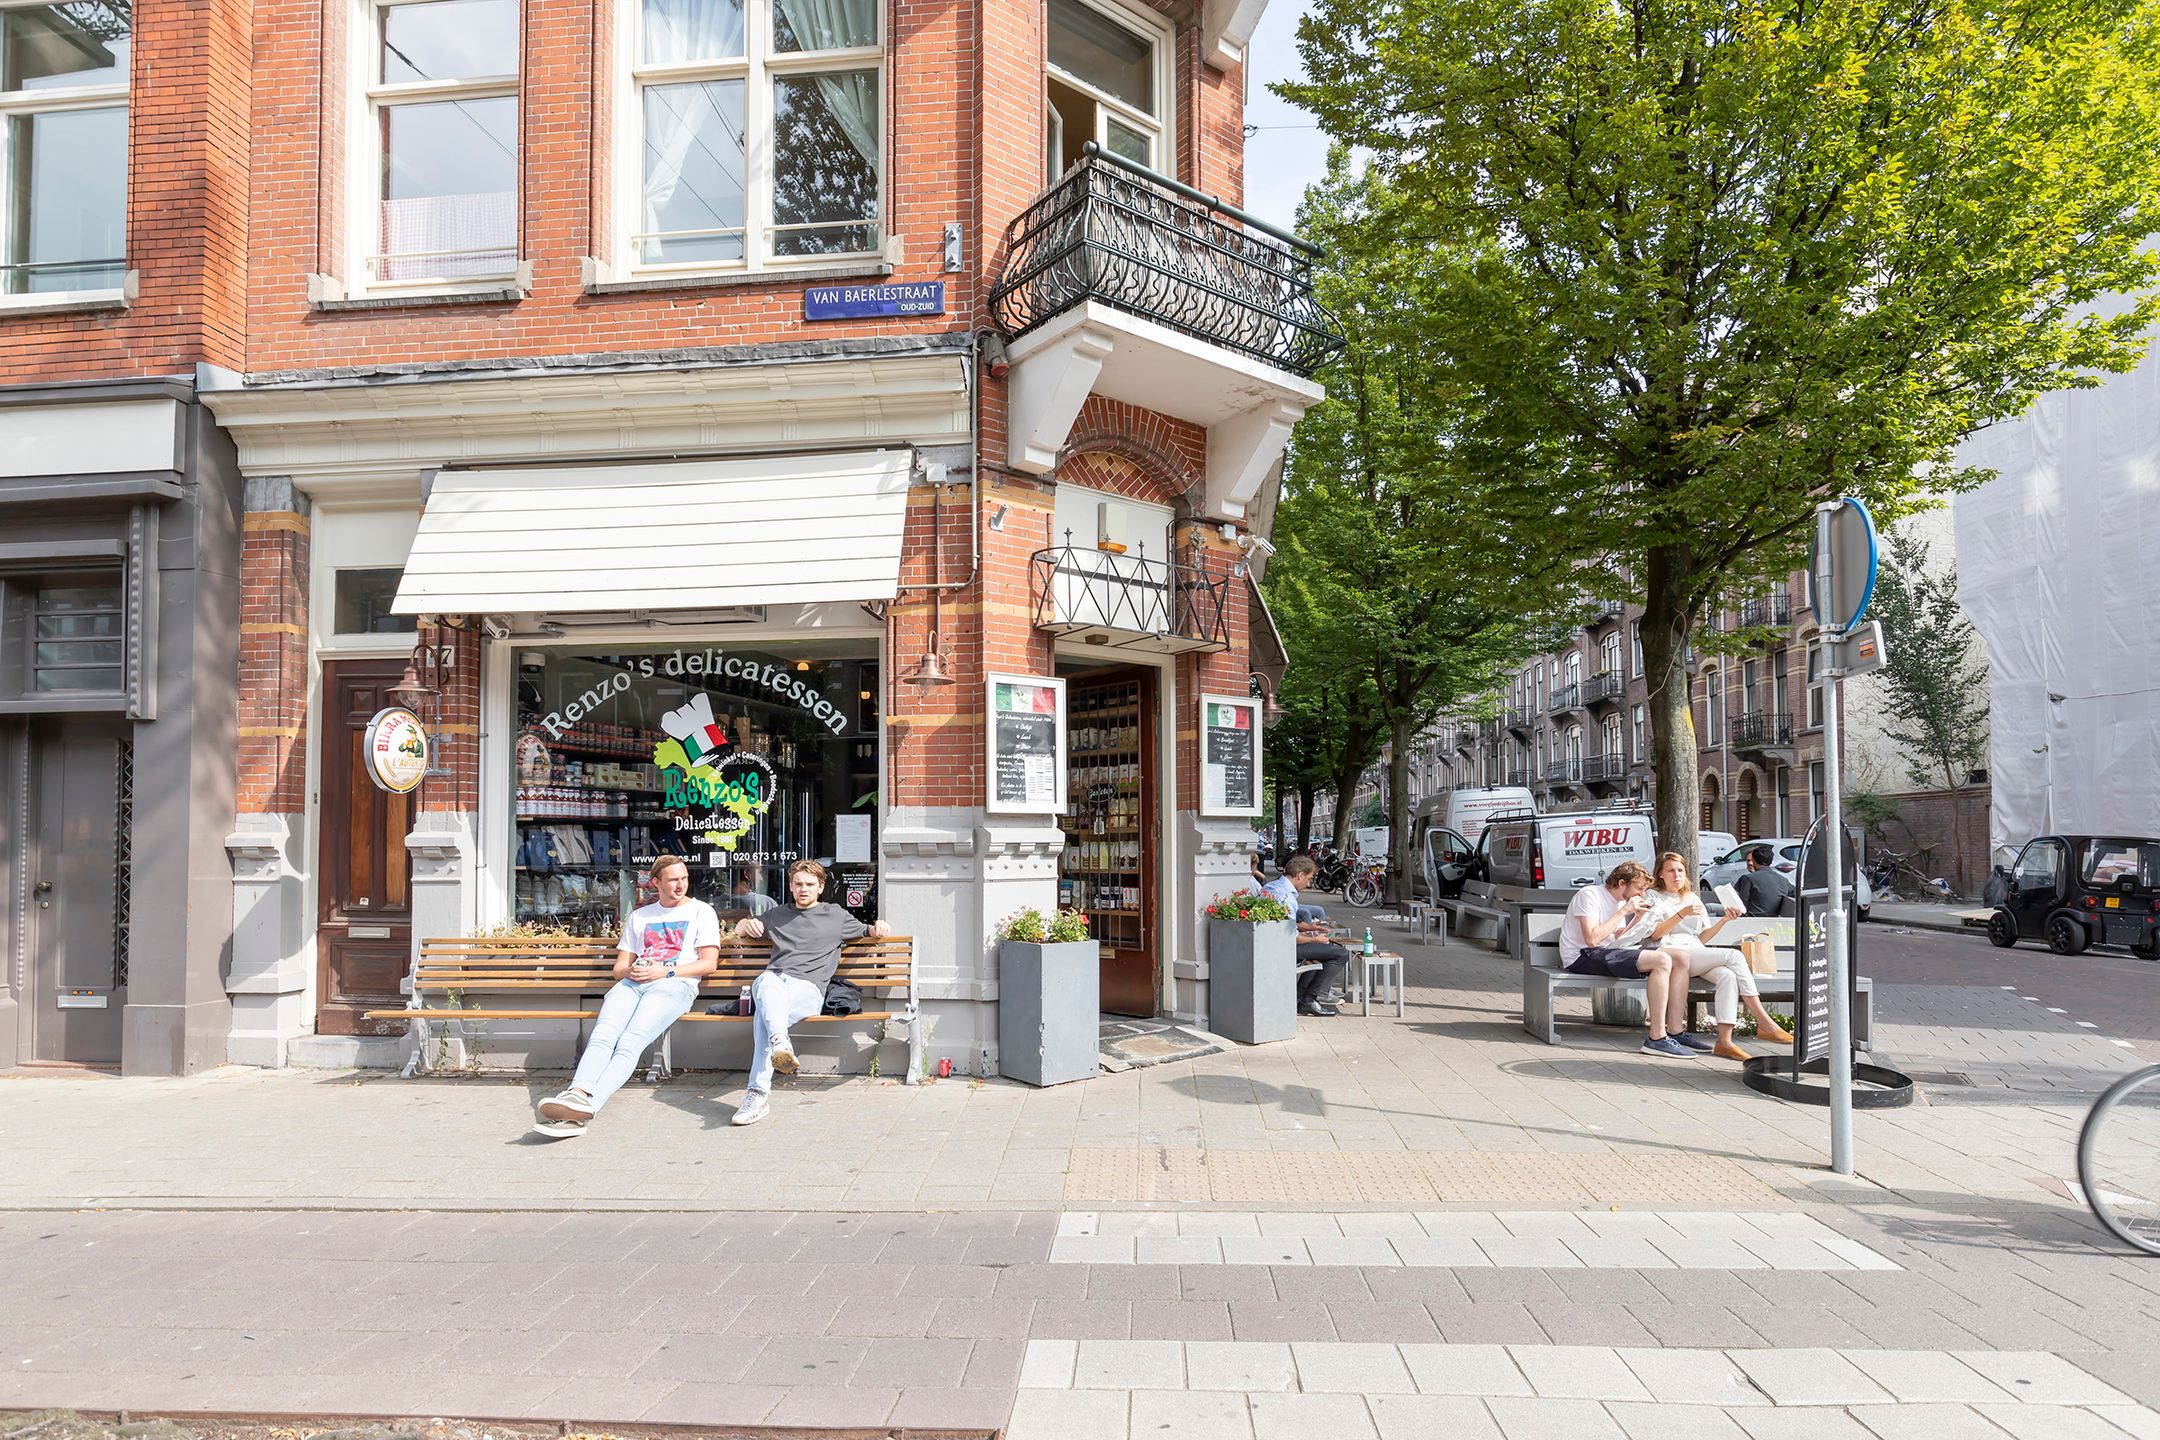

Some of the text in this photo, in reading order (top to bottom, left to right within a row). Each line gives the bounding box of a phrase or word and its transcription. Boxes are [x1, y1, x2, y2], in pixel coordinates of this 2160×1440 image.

[813, 285, 937, 304] VAN BAERLESTRAAT
[901, 302, 935, 311] OUD-ZUID
[540, 648, 849, 741] Renzo's delicatessen
[663, 768, 759, 809] Renzo's
[675, 812, 751, 831] Delicatessen
[692, 835, 714, 844] Sinds
[1563, 828, 1631, 848] WIBU
[733, 851, 797, 862] 020 673 1 673
[1569, 847, 1617, 855] DAKWERKEN
